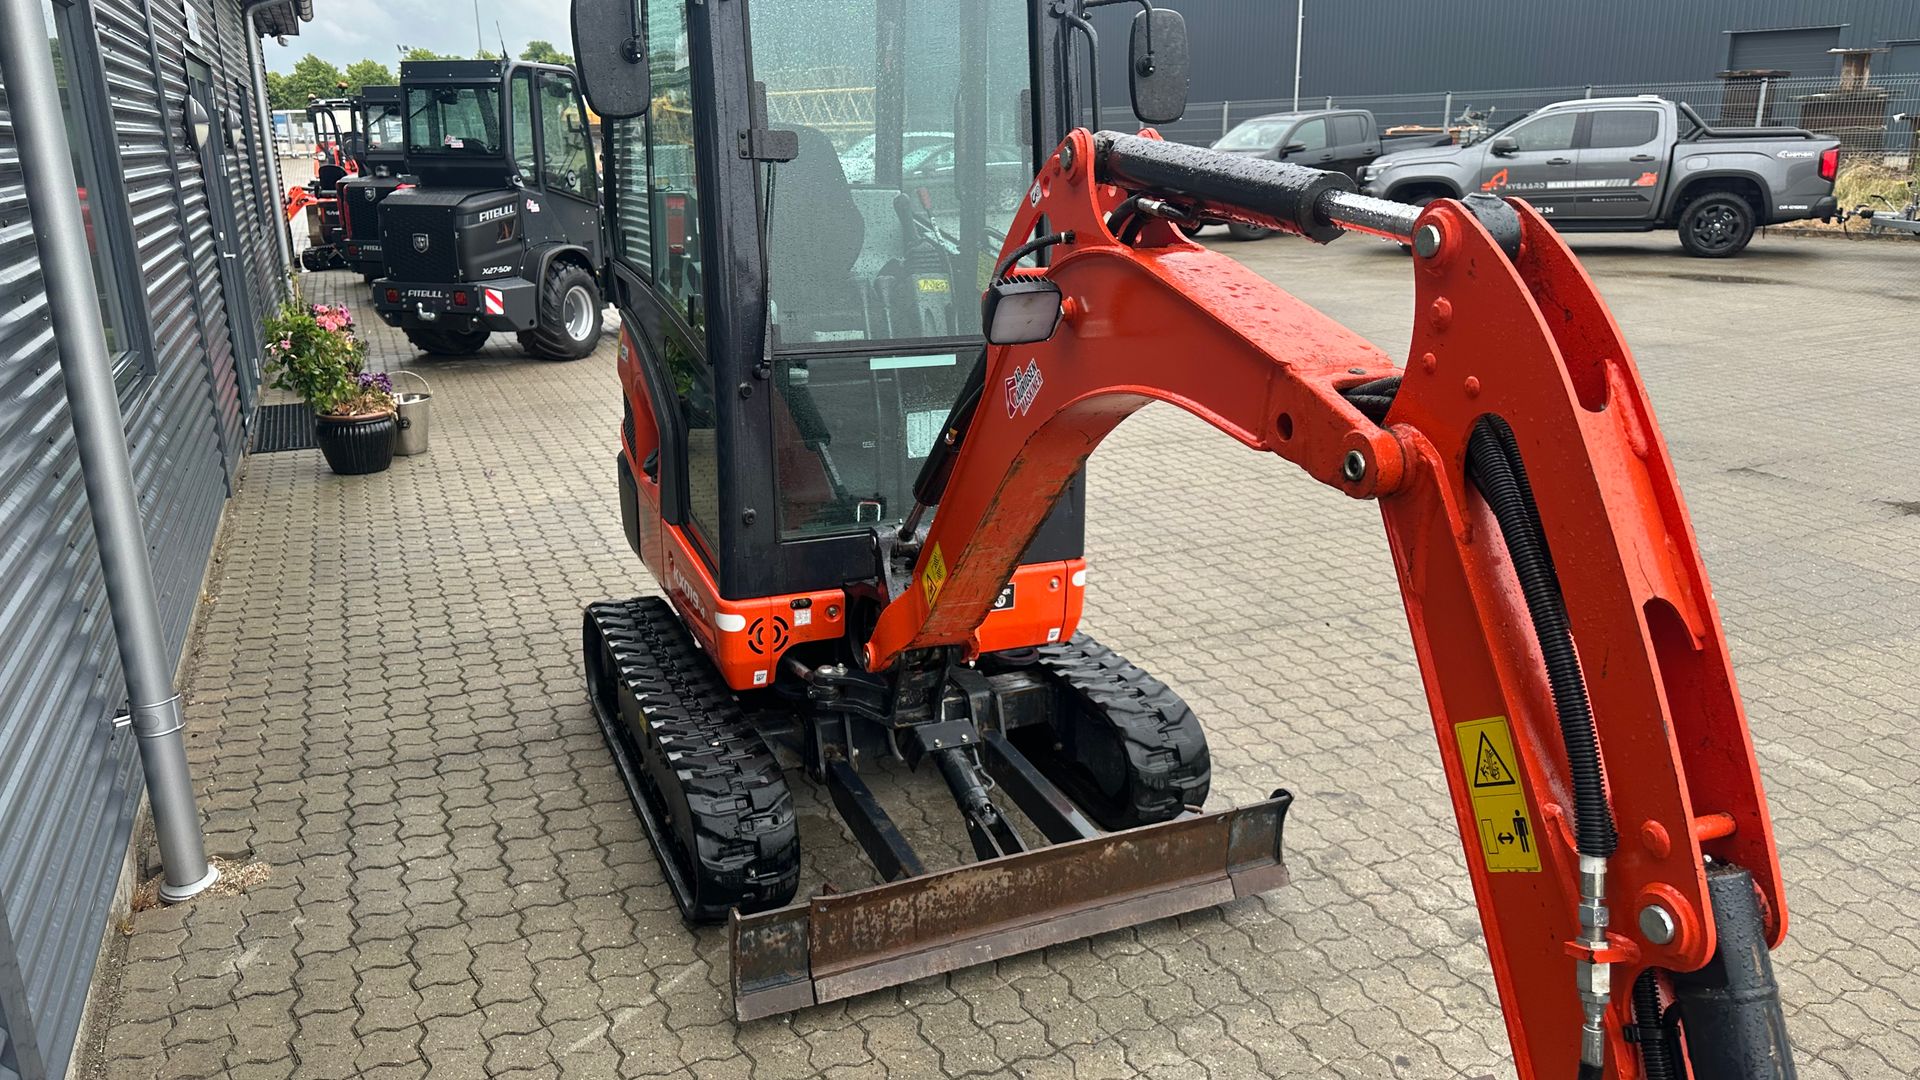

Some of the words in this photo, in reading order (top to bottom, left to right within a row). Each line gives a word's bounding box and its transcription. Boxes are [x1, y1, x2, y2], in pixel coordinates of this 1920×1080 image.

[1505, 182, 1545, 190] NYGAARD
[479, 204, 515, 222] PITBULL
[407, 289, 443, 298] PITBULL
[1020, 370, 1043, 416] MASKINER
[673, 568, 706, 619] KX019-4
